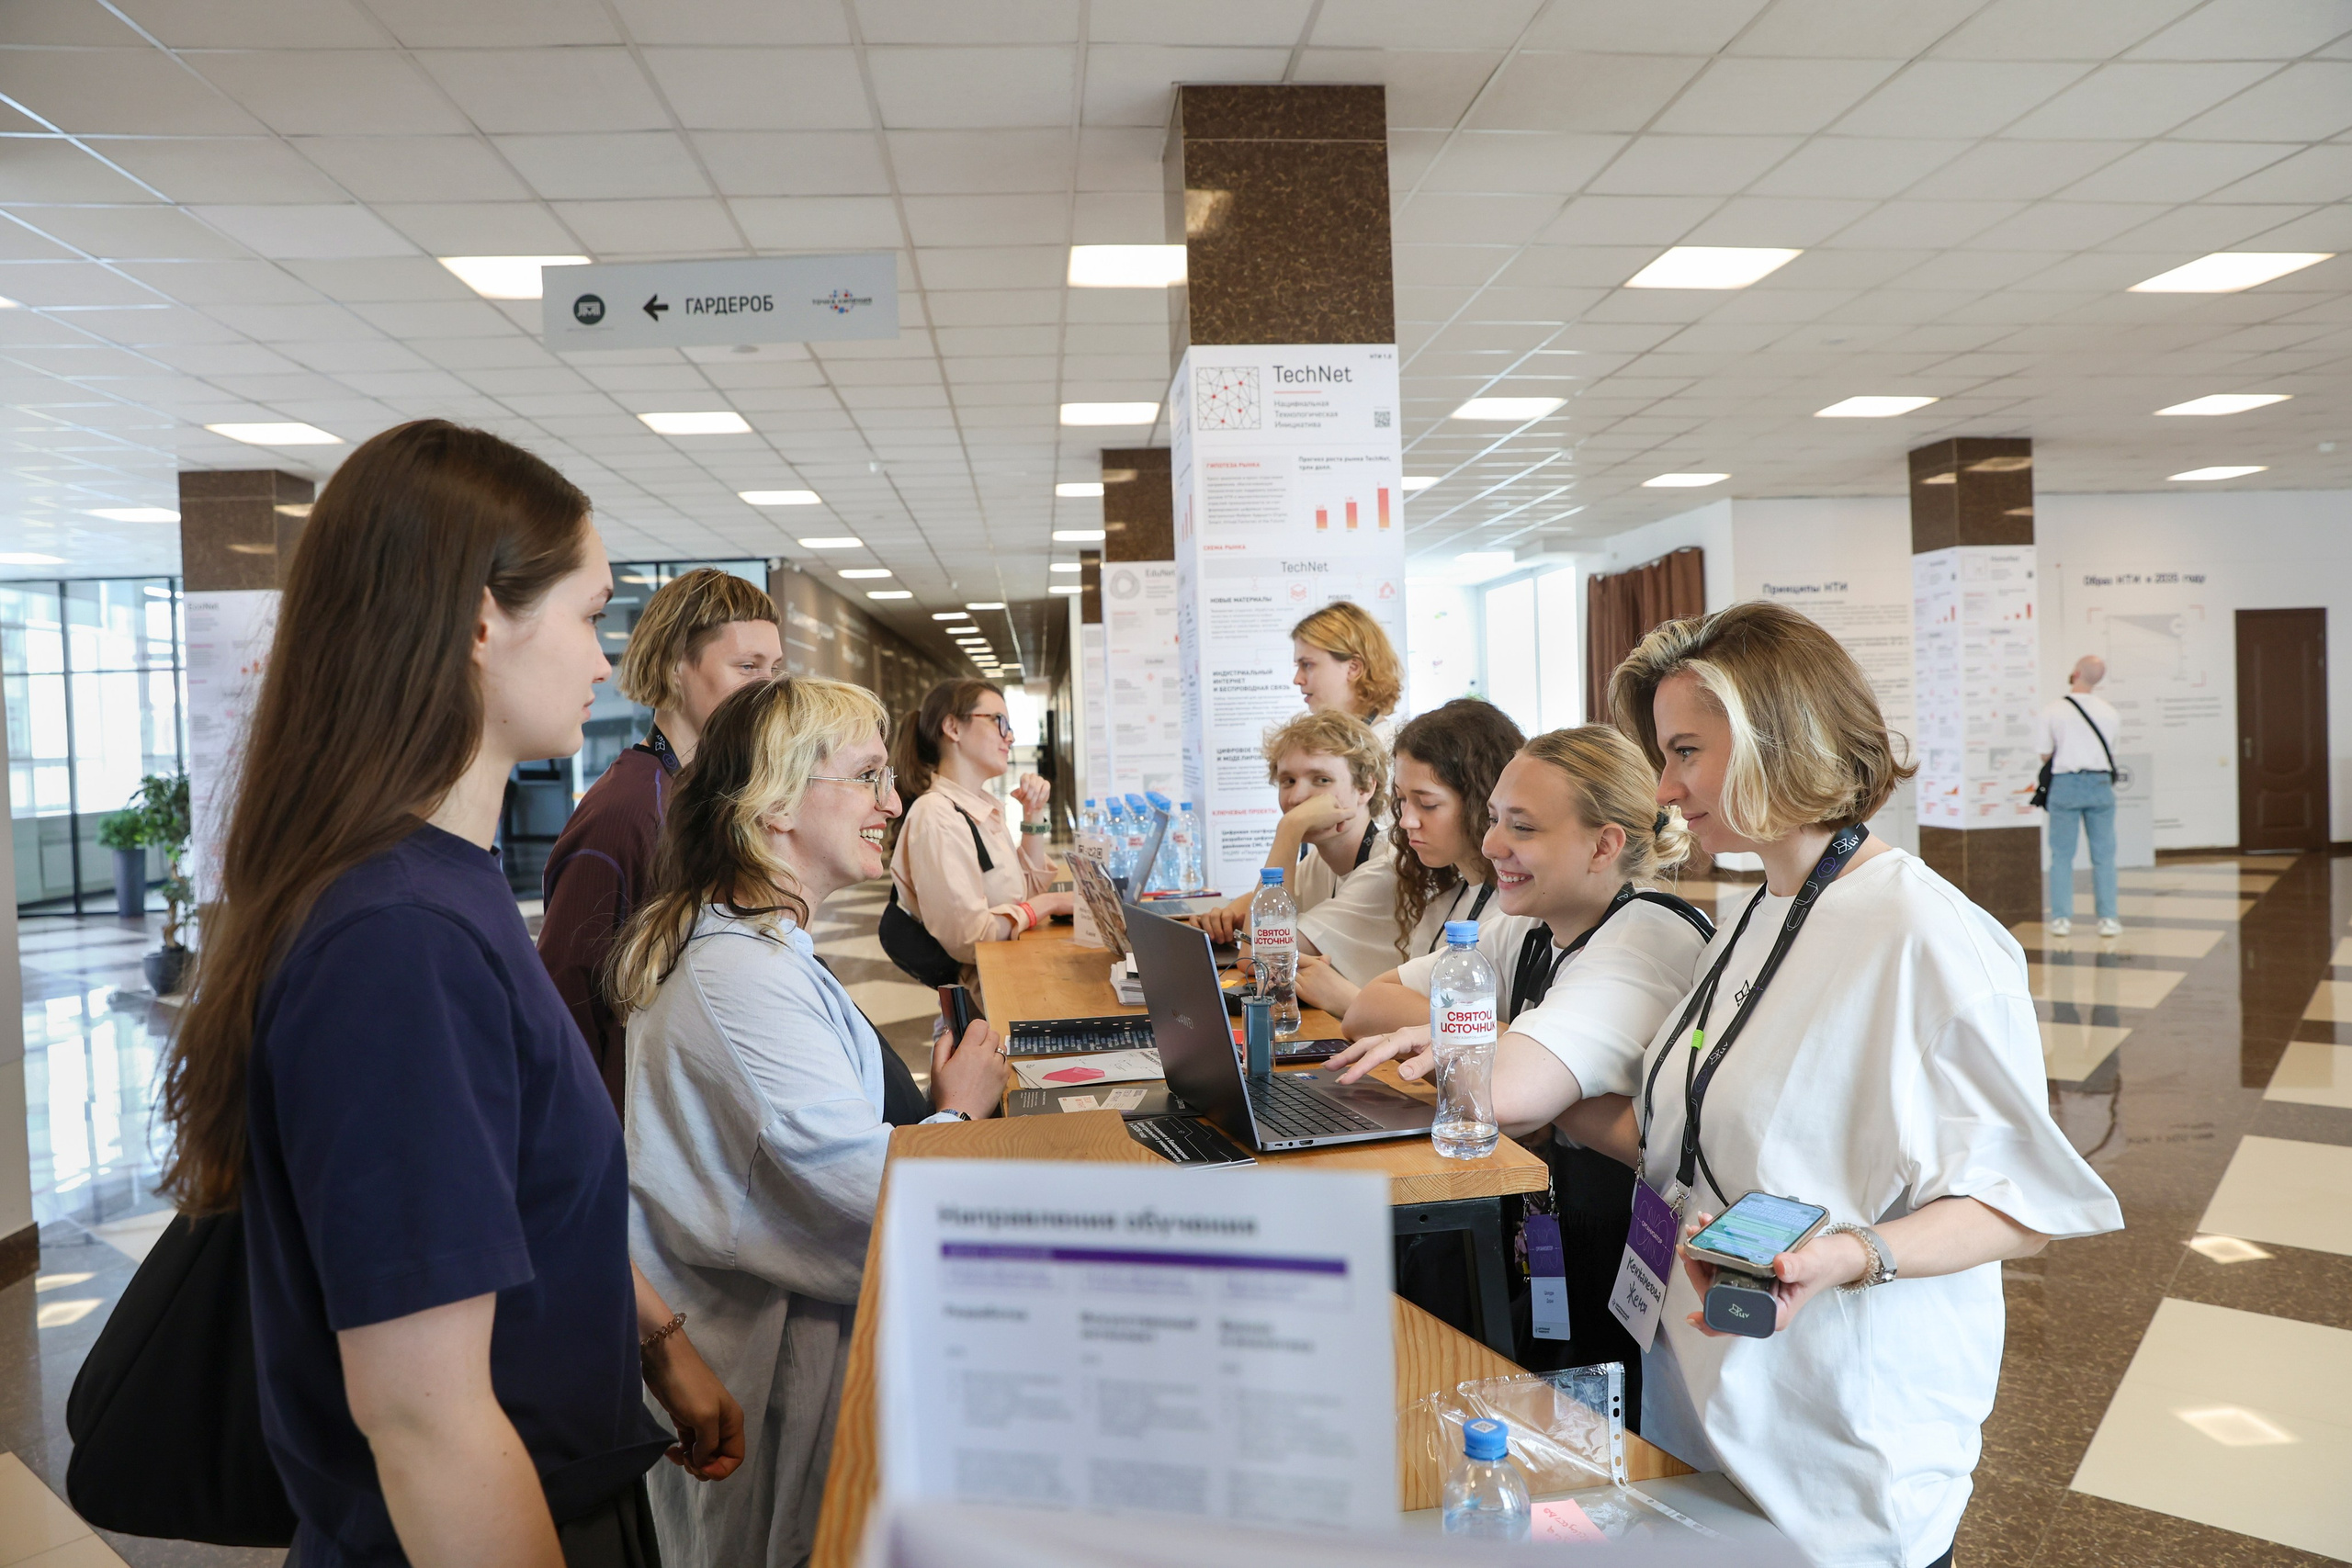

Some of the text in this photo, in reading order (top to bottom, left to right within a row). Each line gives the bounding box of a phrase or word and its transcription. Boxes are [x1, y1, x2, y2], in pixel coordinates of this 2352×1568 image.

[685, 295, 775, 315] ГАРДЕРОБ
[1272, 365, 1353, 384] TechNet
[1273, 400, 1329, 408] Национальная
[1274, 410, 1339, 418] Технологическая
[1274, 421, 1321, 429] Инициатива
[1281, 560, 1329, 573] TechNet
[2116, 574, 2141, 584] НТИ
[1762, 581, 1849, 595] Принципы НТИ
[1257, 927, 1290, 937] СВЯТОЙ
[1254, 936, 1295, 945] ИСТОЧНИК
[1447, 1008, 1493, 1021] СВЯТОЙ
[1441, 1021, 1497, 1033] ИСТОЧНИК
[937, 1203, 1259, 1240] Направления обучения
[1641, 1220, 1664, 1245] ОРГАНИЗАТОР
[1626, 1280, 1648, 1315] Женя
